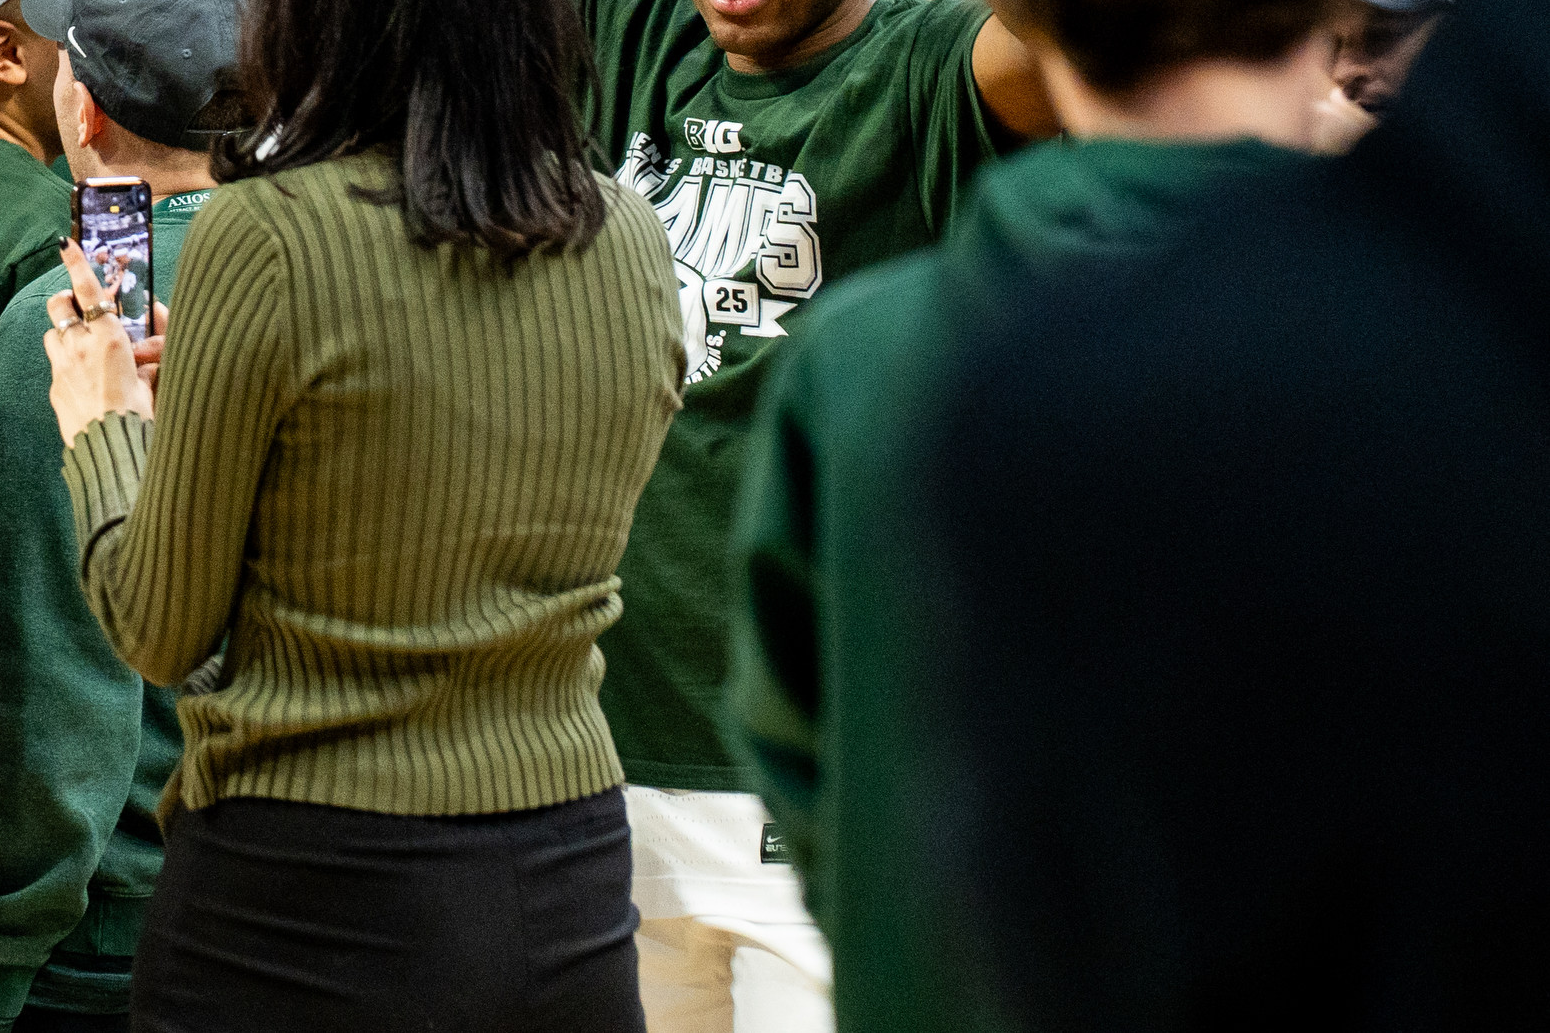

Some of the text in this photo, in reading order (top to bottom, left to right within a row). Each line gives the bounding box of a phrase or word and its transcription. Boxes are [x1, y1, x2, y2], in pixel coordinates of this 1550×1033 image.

[630, 131, 785, 184] EN'S BASKETB
[168, 192, 210, 208] AXIOS
[715, 286, 749, 314] 25
